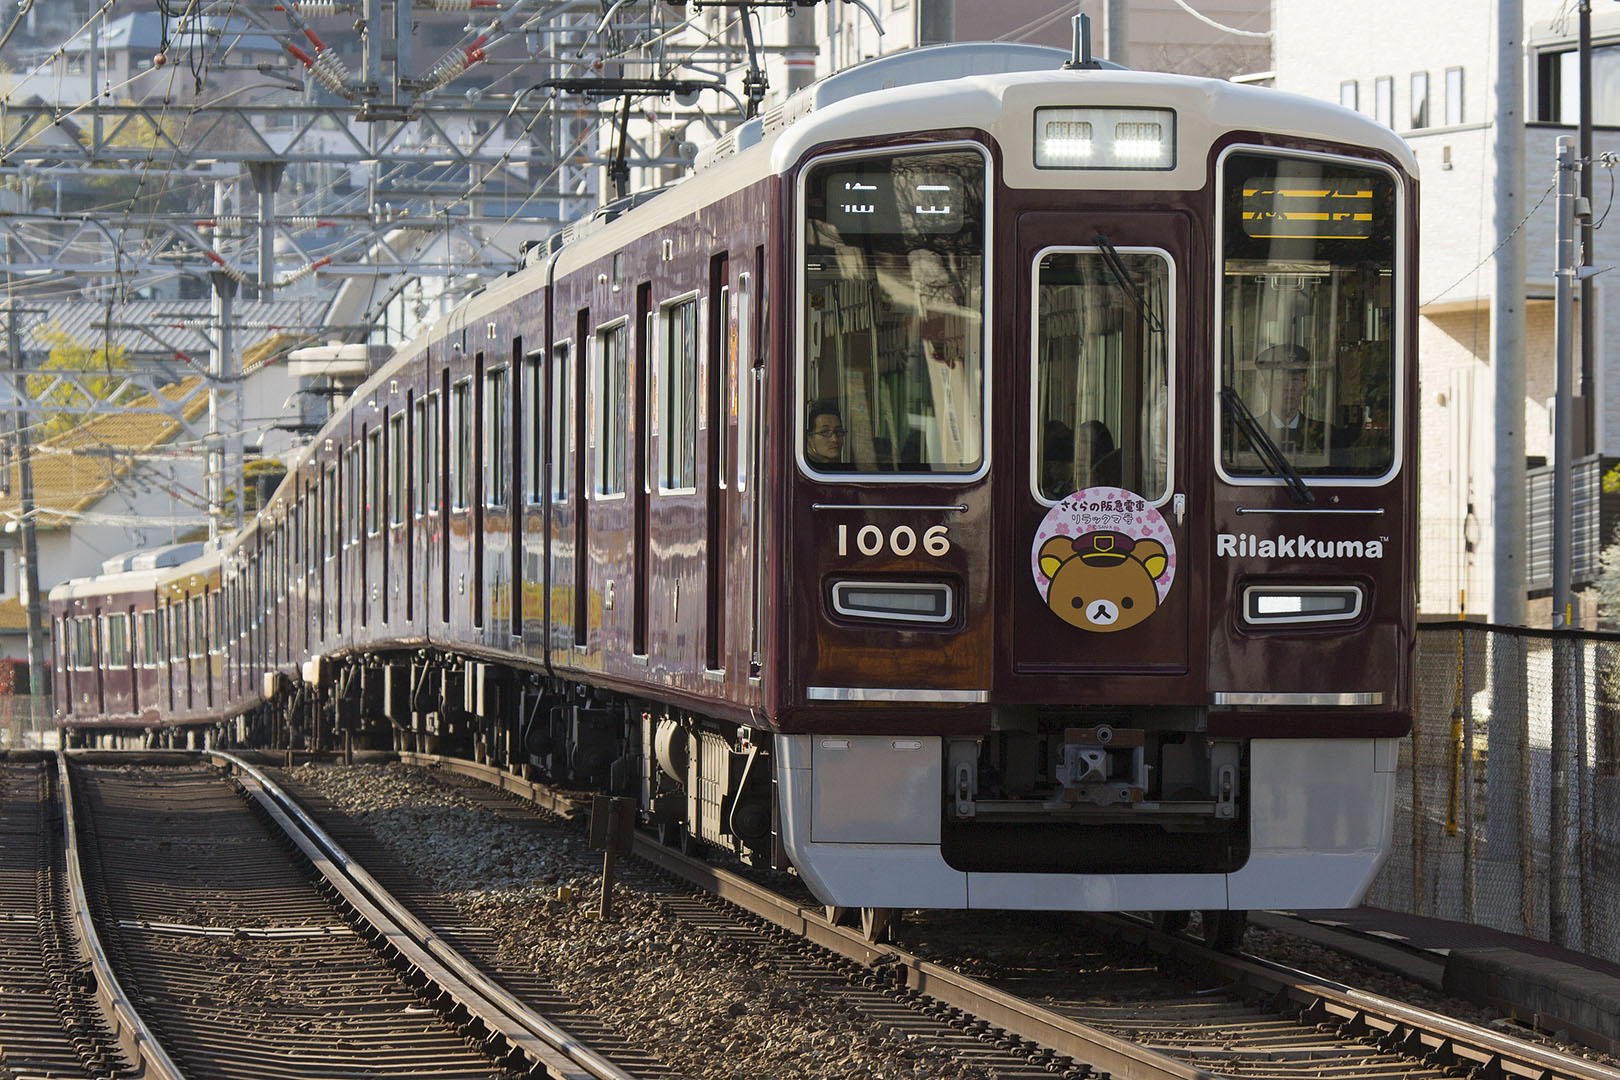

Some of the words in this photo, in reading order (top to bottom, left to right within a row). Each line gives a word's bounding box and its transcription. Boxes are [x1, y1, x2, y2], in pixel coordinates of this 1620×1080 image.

[1061, 500, 1145, 512] さくらの阪急電車
[1072, 513, 1134, 525] リラックマ号
[838, 524, 950, 557] 1006
